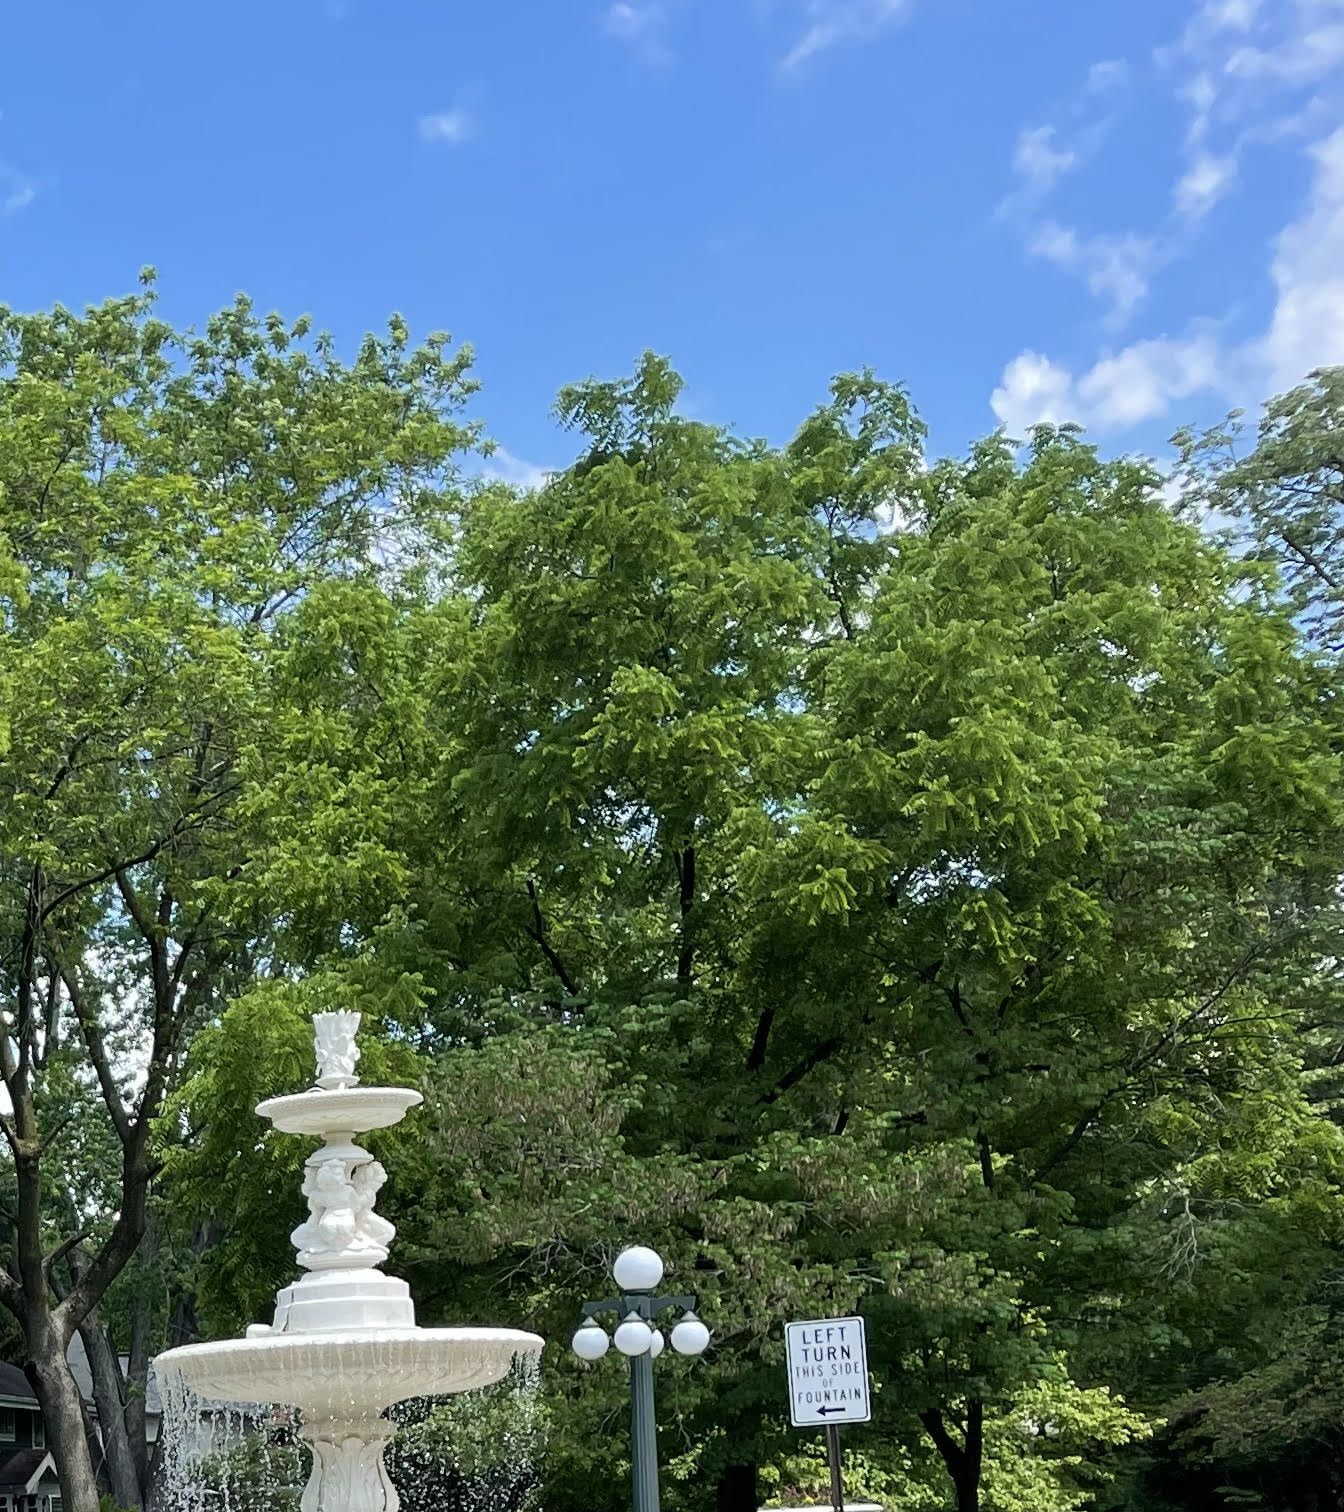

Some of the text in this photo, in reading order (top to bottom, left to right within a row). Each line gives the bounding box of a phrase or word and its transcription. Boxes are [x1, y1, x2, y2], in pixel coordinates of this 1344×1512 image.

[802, 1326, 846, 1345] LEFT
[801, 1345, 851, 1363] TURN
[795, 1361, 861, 1378] THIS SIDE
[822, 1378, 833, 1389] OF
[798, 1387, 861, 1404] FOUNTAIN
